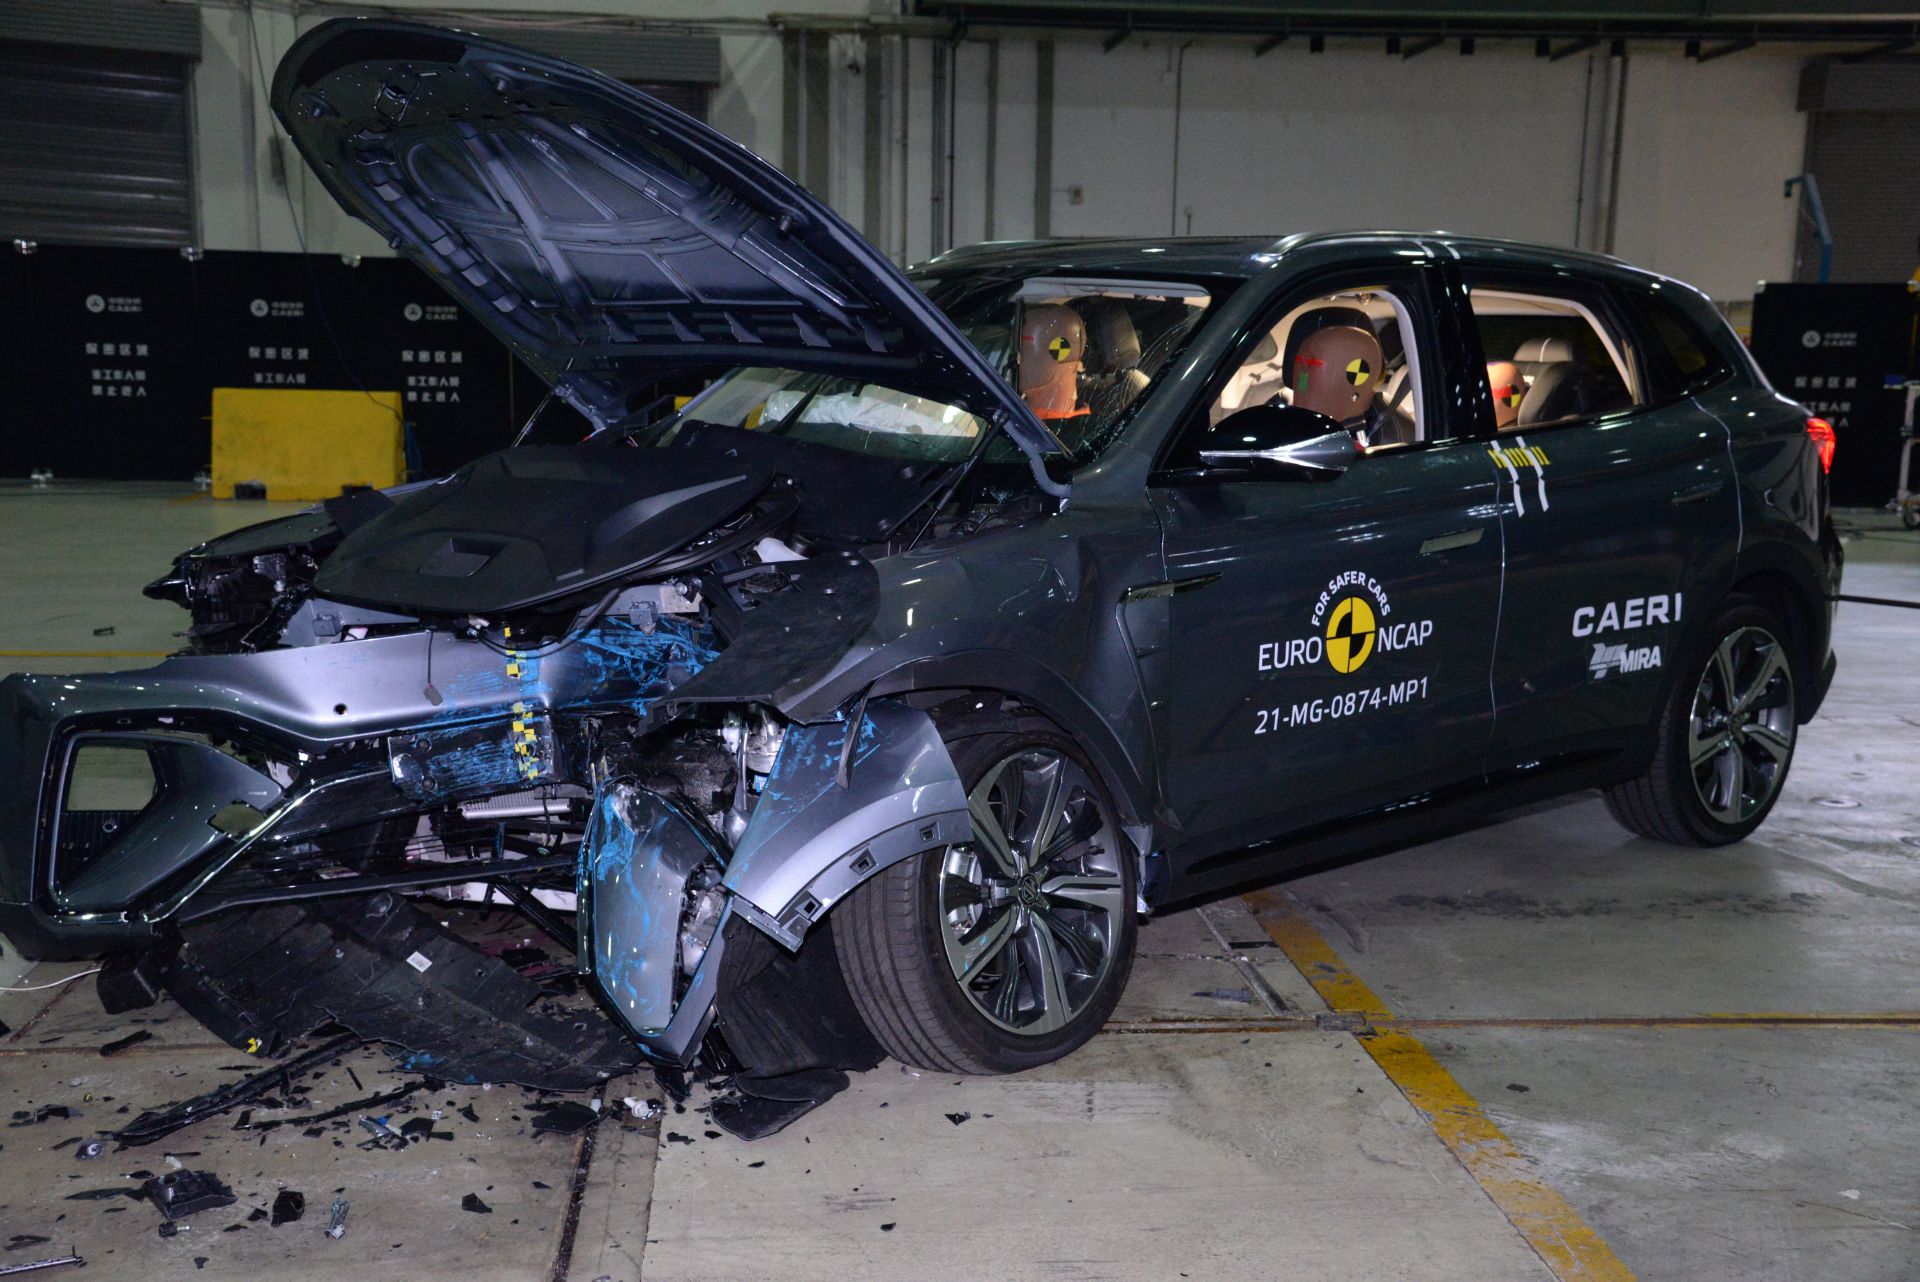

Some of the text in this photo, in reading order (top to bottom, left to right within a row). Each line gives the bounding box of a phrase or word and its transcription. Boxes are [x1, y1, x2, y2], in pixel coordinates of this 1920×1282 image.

[1311, 570, 1391, 627] FOR SAFER CARS
[1572, 592, 1682, 637] CAERI
[1258, 619, 1433, 672] EURO NCAP
[1619, 645, 1662, 674] MIRA
[1254, 676, 1428, 735] 21-MG-0874-MP1
